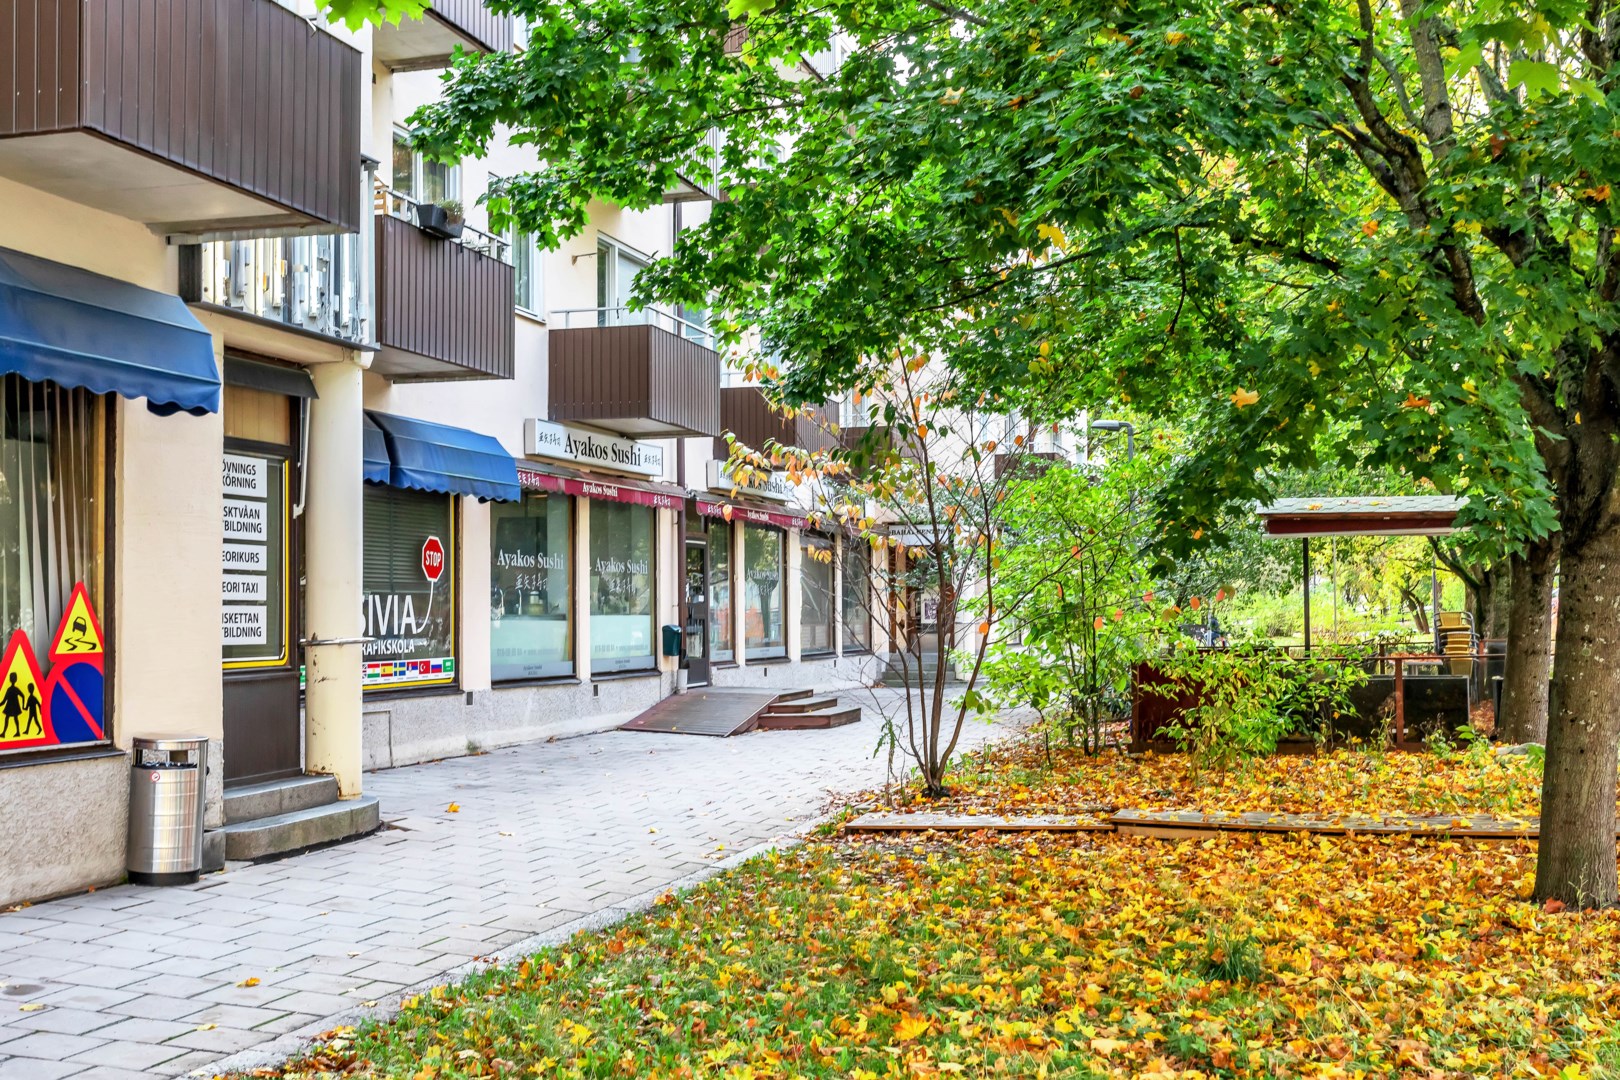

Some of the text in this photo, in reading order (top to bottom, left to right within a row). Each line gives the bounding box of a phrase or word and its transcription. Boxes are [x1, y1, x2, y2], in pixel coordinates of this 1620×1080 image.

[564, 433, 642, 467] Ayakos Sushi
[582, 482, 618, 497] Ayakos Sushi
[223, 505, 260, 520] SKTVÅAN
[223, 520, 262, 534] BILDNING
[425, 550, 441, 567] STOP
[497, 549, 564, 571] Ayakos Sushi
[595, 556, 648, 574] Ayakos Sushi
[241, 582, 259, 593] TAXI
[222, 626, 262, 638] BILDNING
